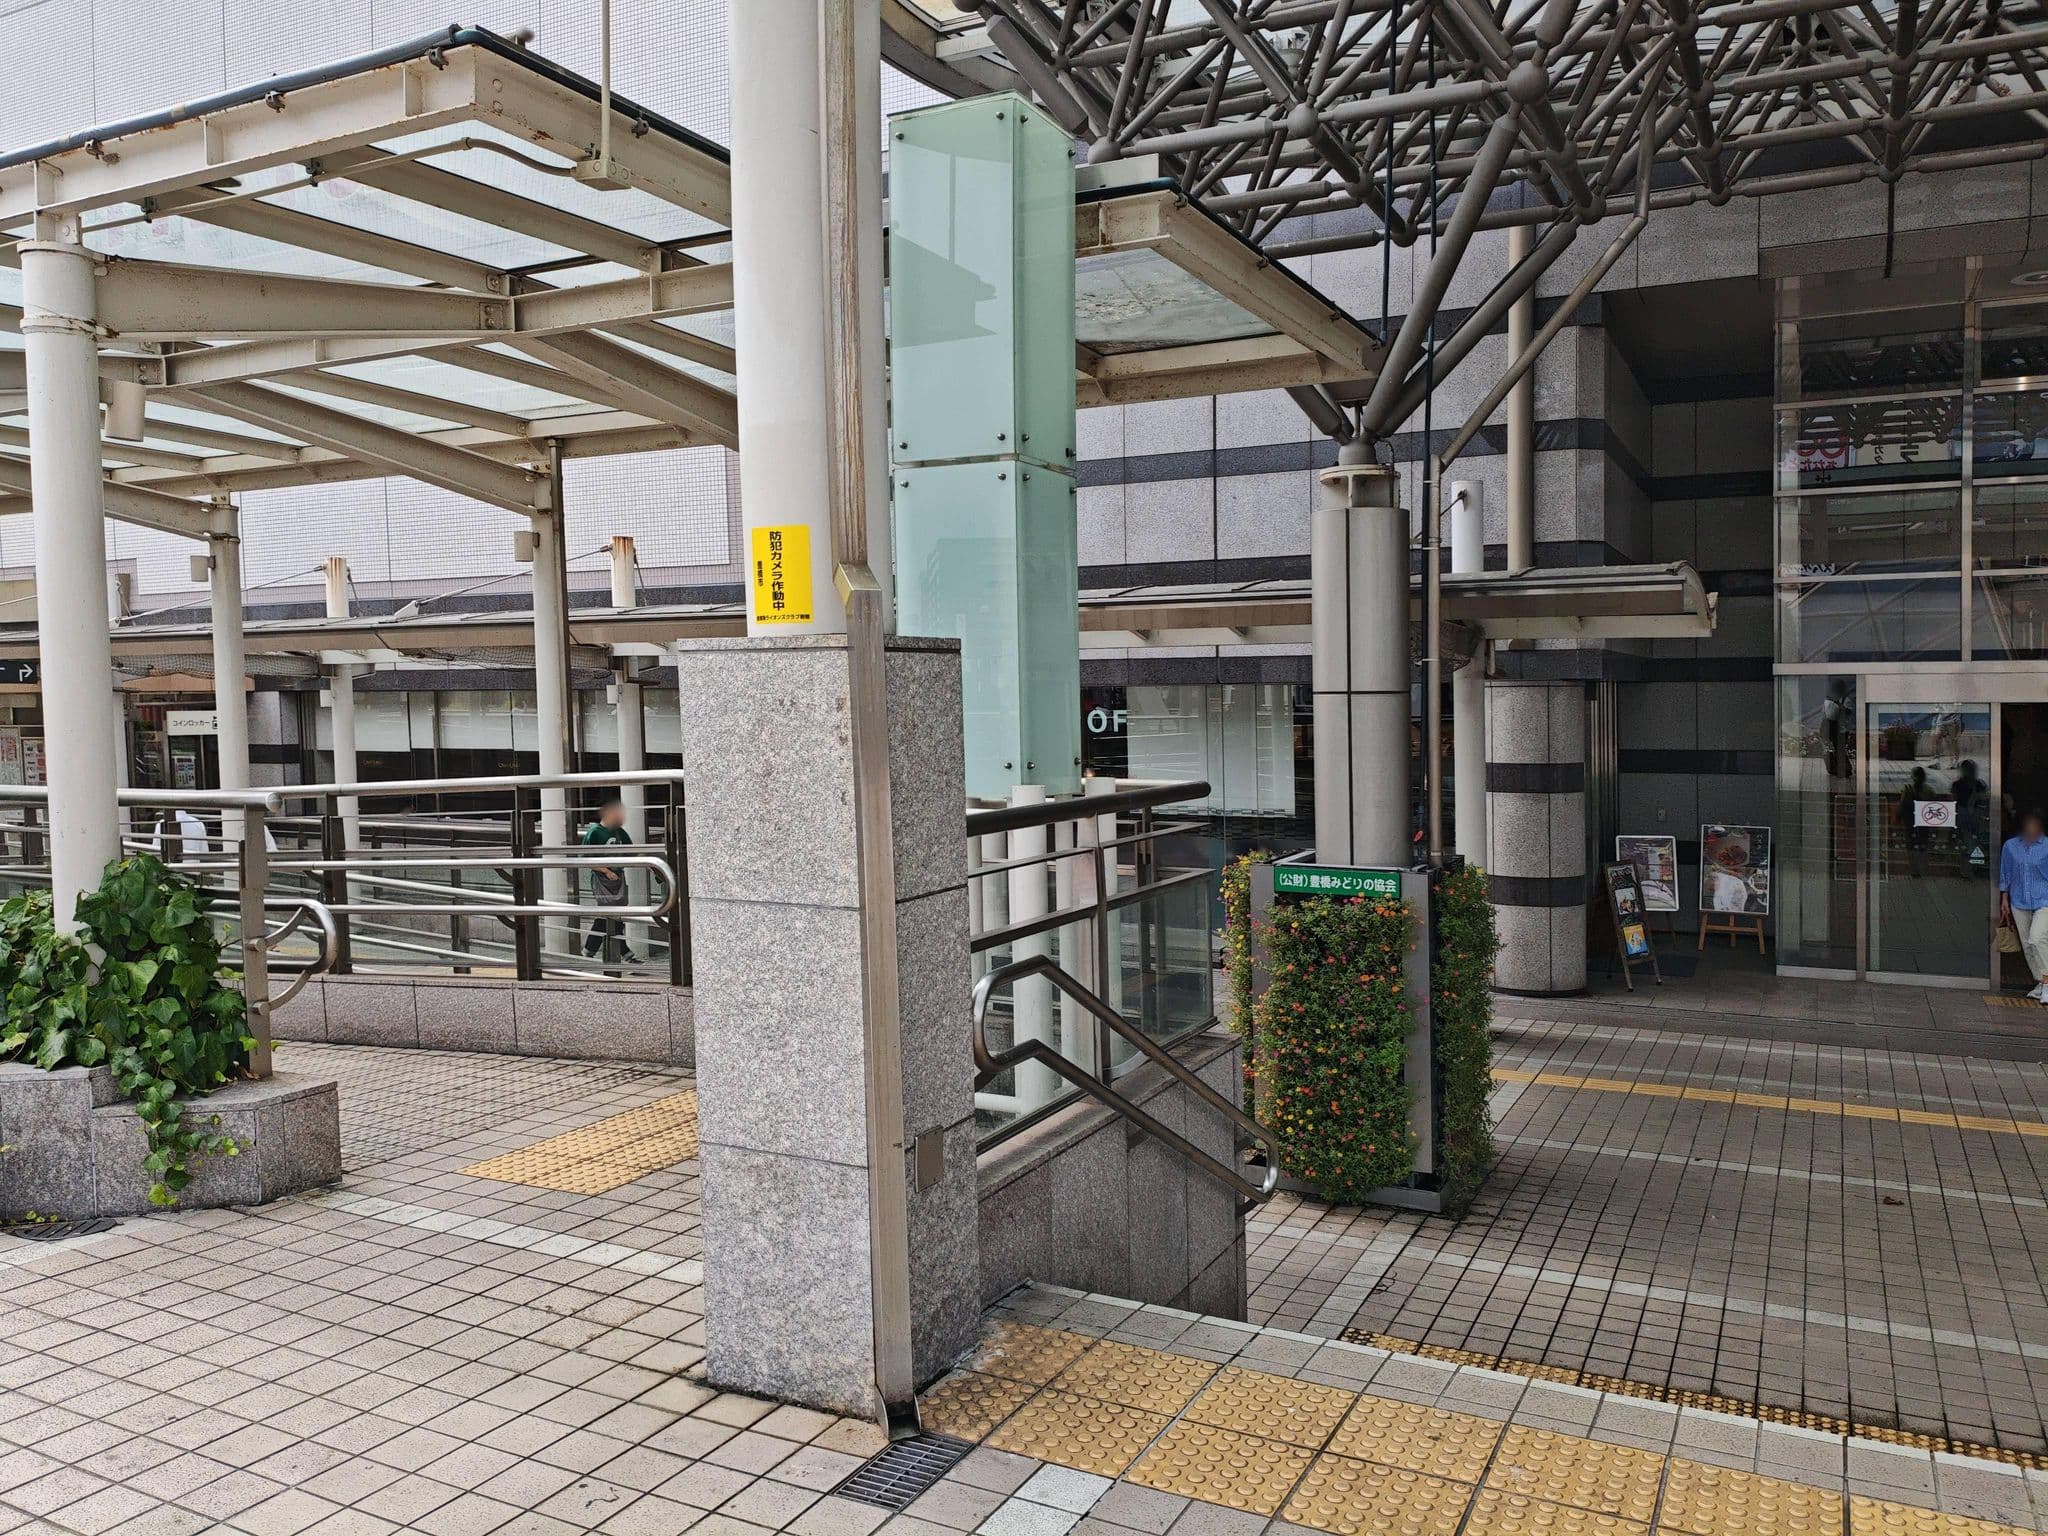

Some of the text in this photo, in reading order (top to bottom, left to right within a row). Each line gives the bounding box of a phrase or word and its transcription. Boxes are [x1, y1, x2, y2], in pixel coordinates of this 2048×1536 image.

[770, 531, 785, 611] 防犯カメラ作動中
